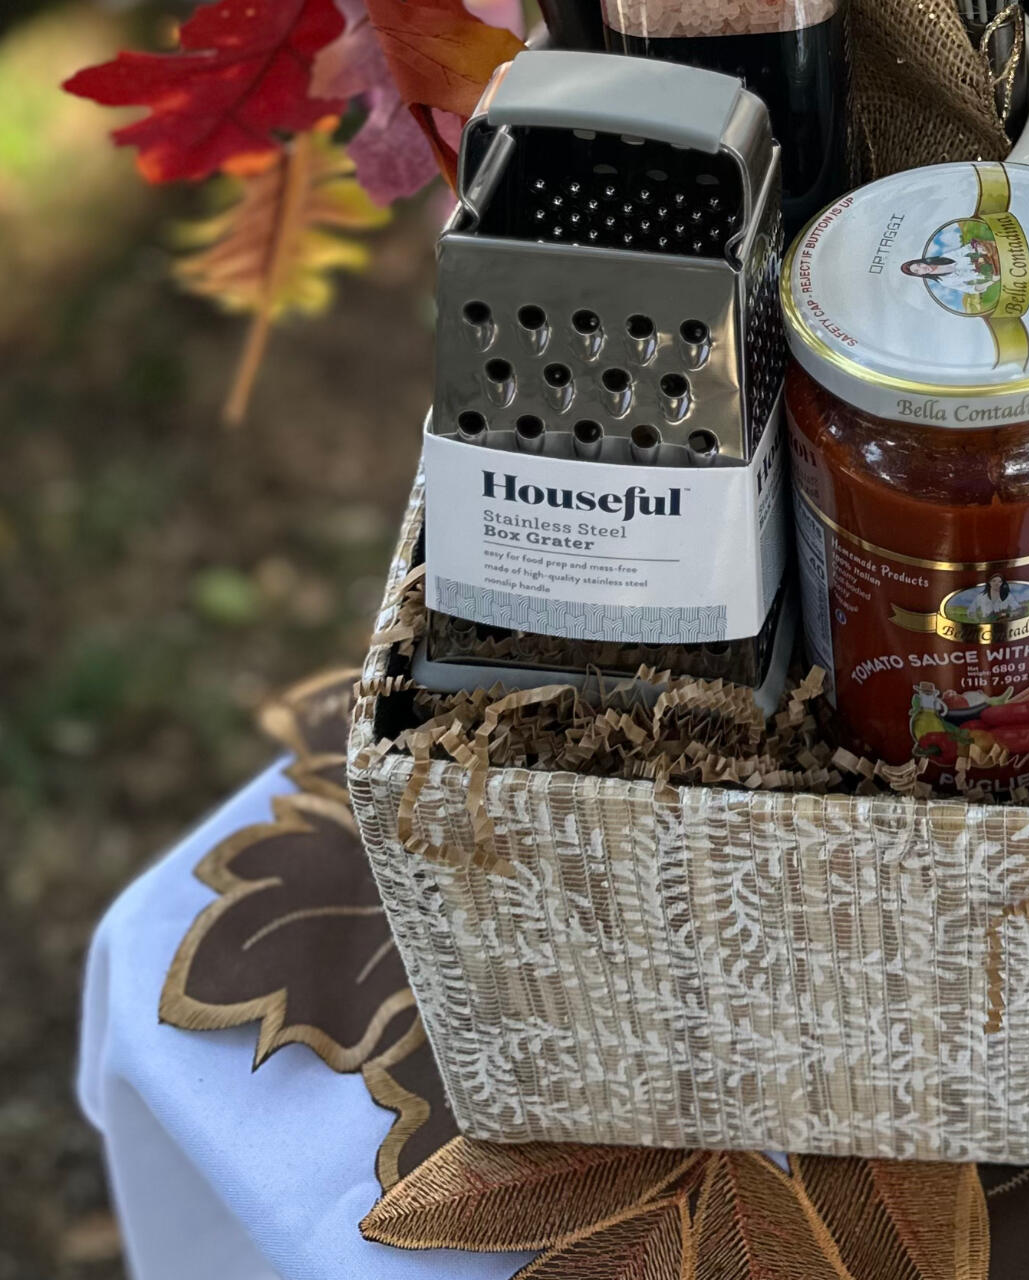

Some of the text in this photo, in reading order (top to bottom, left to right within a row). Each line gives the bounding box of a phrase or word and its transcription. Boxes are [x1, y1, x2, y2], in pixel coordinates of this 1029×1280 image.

[800, 196, 858, 347] SAFETY CAP REJECT IF BUTTON IS UP
[995, 215, 1028, 314] Bella Contadina
[896, 399, 946, 422] Bella
[482, 471, 681, 521] Houseful
[483, 510, 627, 538] Stainless Steel
[484, 524, 595, 550] Box Grater
[484, 550, 504, 560] easy
[506, 551, 520, 561] for
[522, 554, 543, 565] food
[546, 559, 568, 571] prep
[570, 561, 587, 570] and
[832, 536, 876, 571] Homemade
[880, 564, 929, 588] Products
[484, 562, 648, 588] made of high-quality stainless steel
[484, 576, 551, 593] nonslip handle
[854, 568, 881, 587] Italian
[851, 656, 903, 685] TOMATO
[909, 651, 978, 668] SAUCE
[992, 662, 1026, 674] 680 g
[961, 676, 987, 687] (1lb
